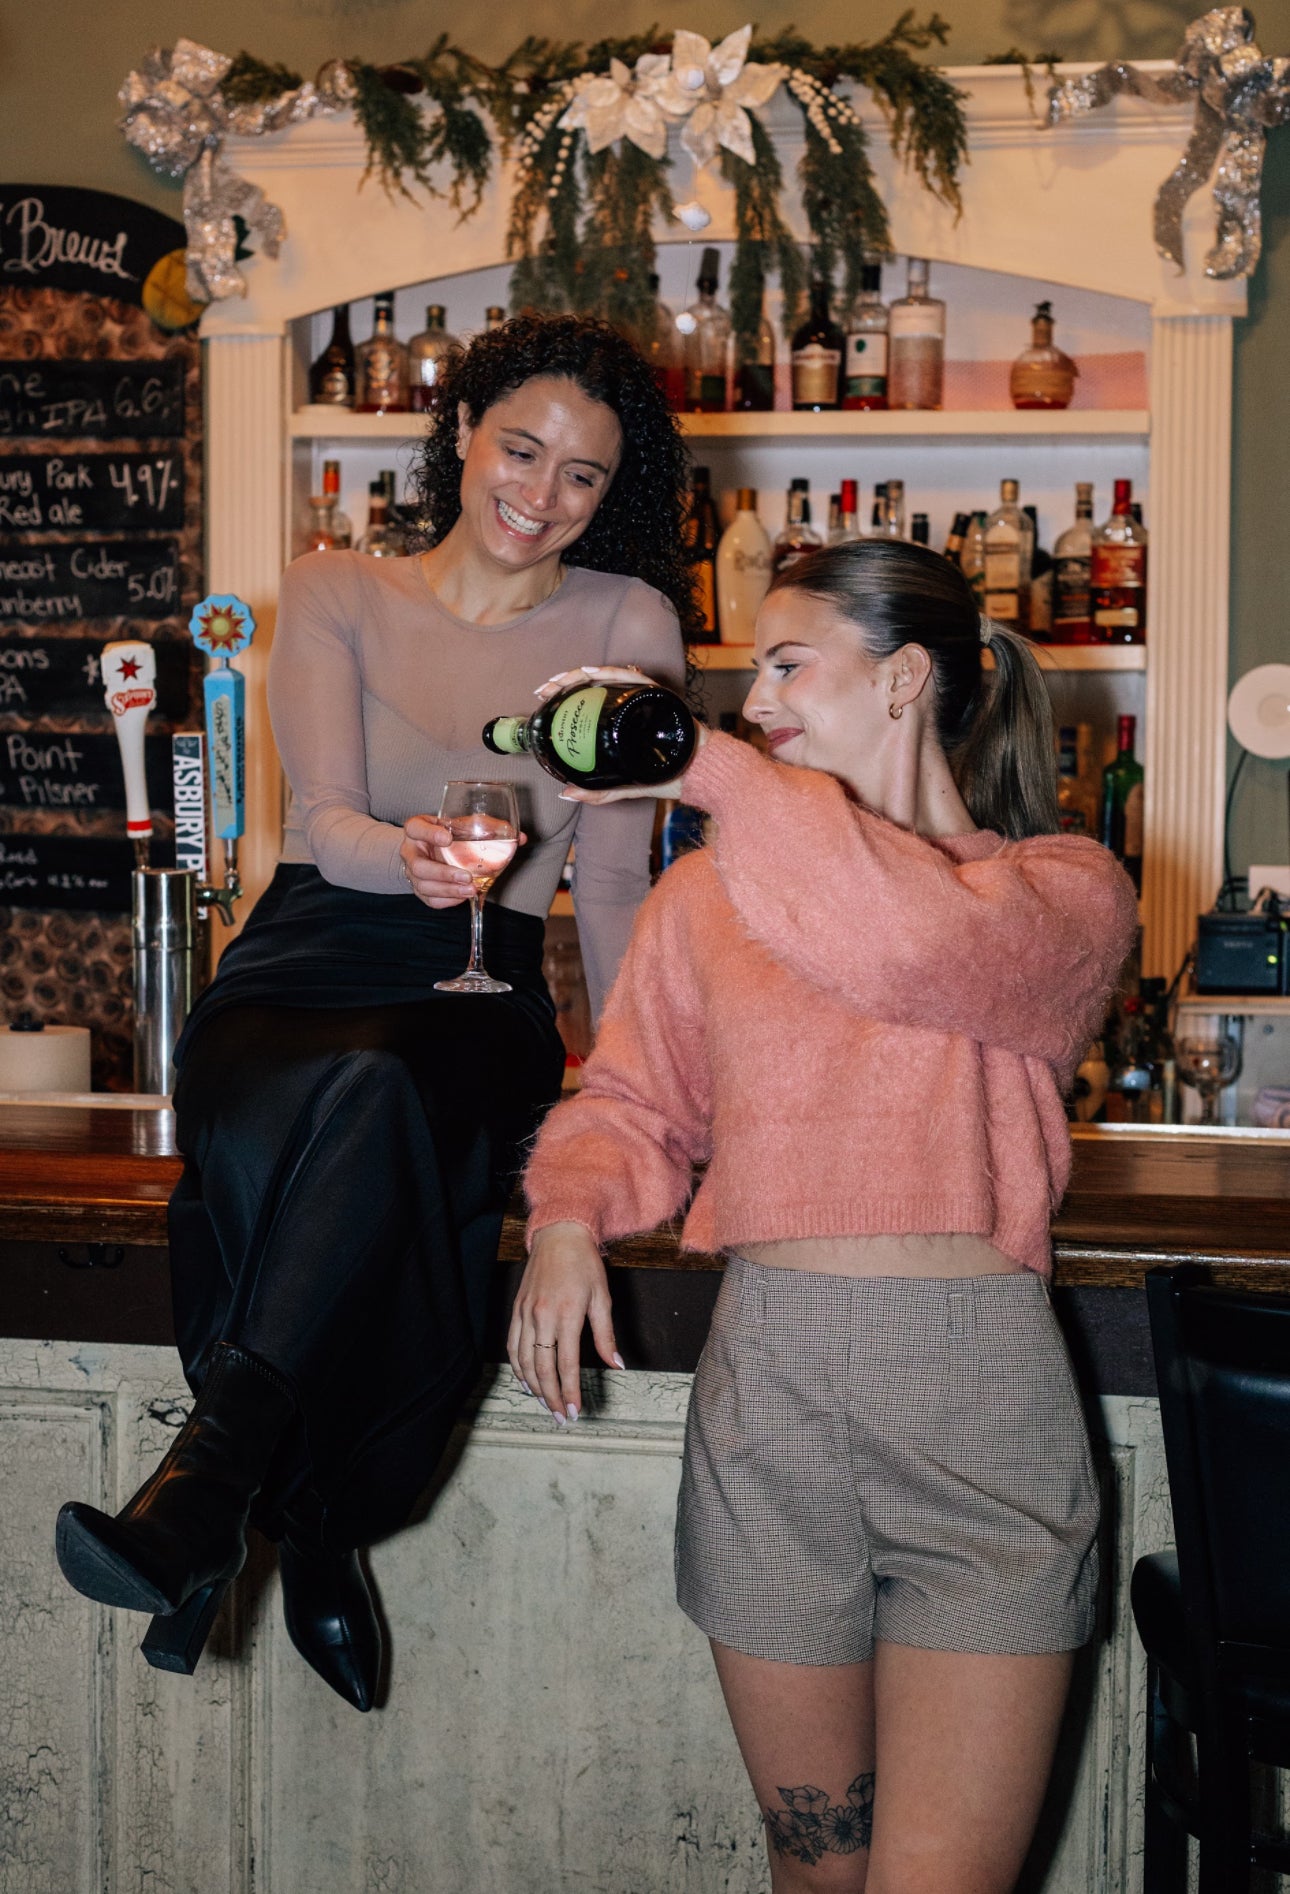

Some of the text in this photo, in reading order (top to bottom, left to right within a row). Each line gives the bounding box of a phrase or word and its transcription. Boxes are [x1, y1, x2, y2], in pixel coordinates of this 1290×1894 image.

[46, 458, 94, 489] Park
[49, 496, 83, 526] ale
[567, 698, 586, 759] Prosecco
[6, 734, 83, 773] Point
[19, 774, 100, 804] Pilsner
[173, 754, 205, 849] ASBURY
